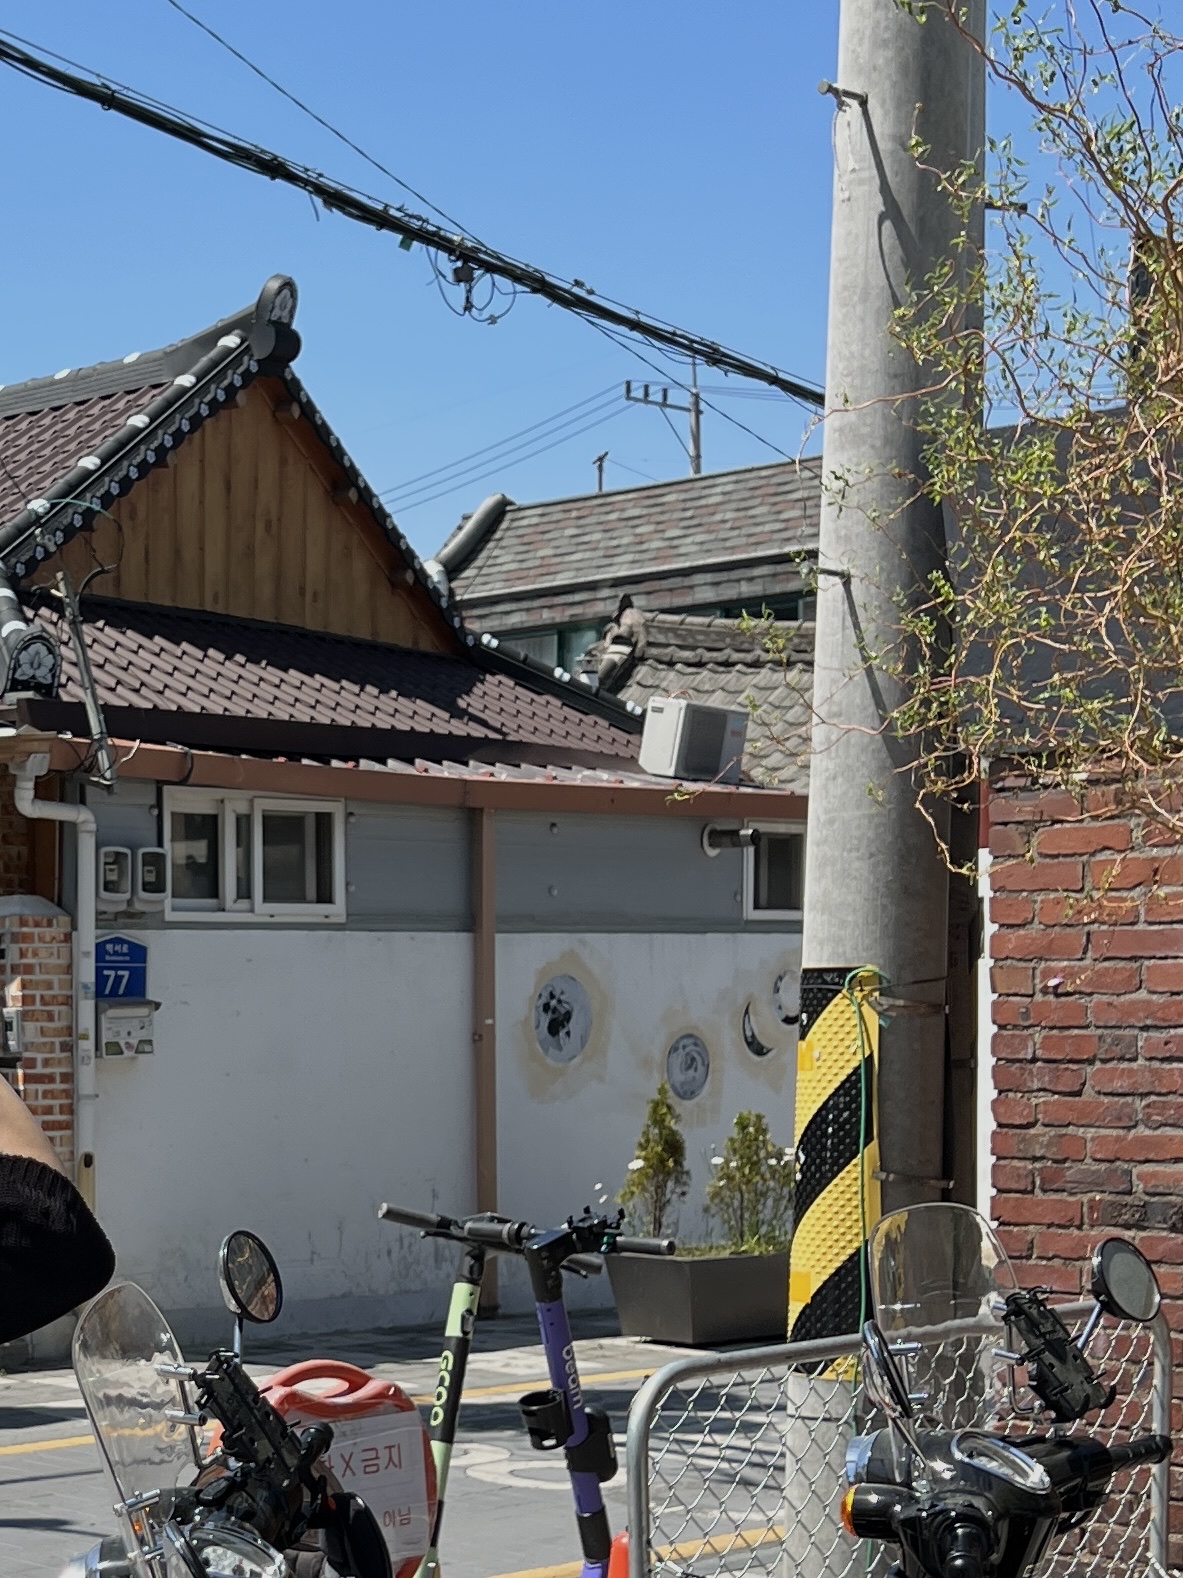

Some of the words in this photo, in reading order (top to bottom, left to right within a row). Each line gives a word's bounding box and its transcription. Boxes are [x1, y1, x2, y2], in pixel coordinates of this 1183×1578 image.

[103, 969, 130, 995] 77
[429, 1349, 454, 1427] GCOO
[562, 1341, 583, 1410] beam
